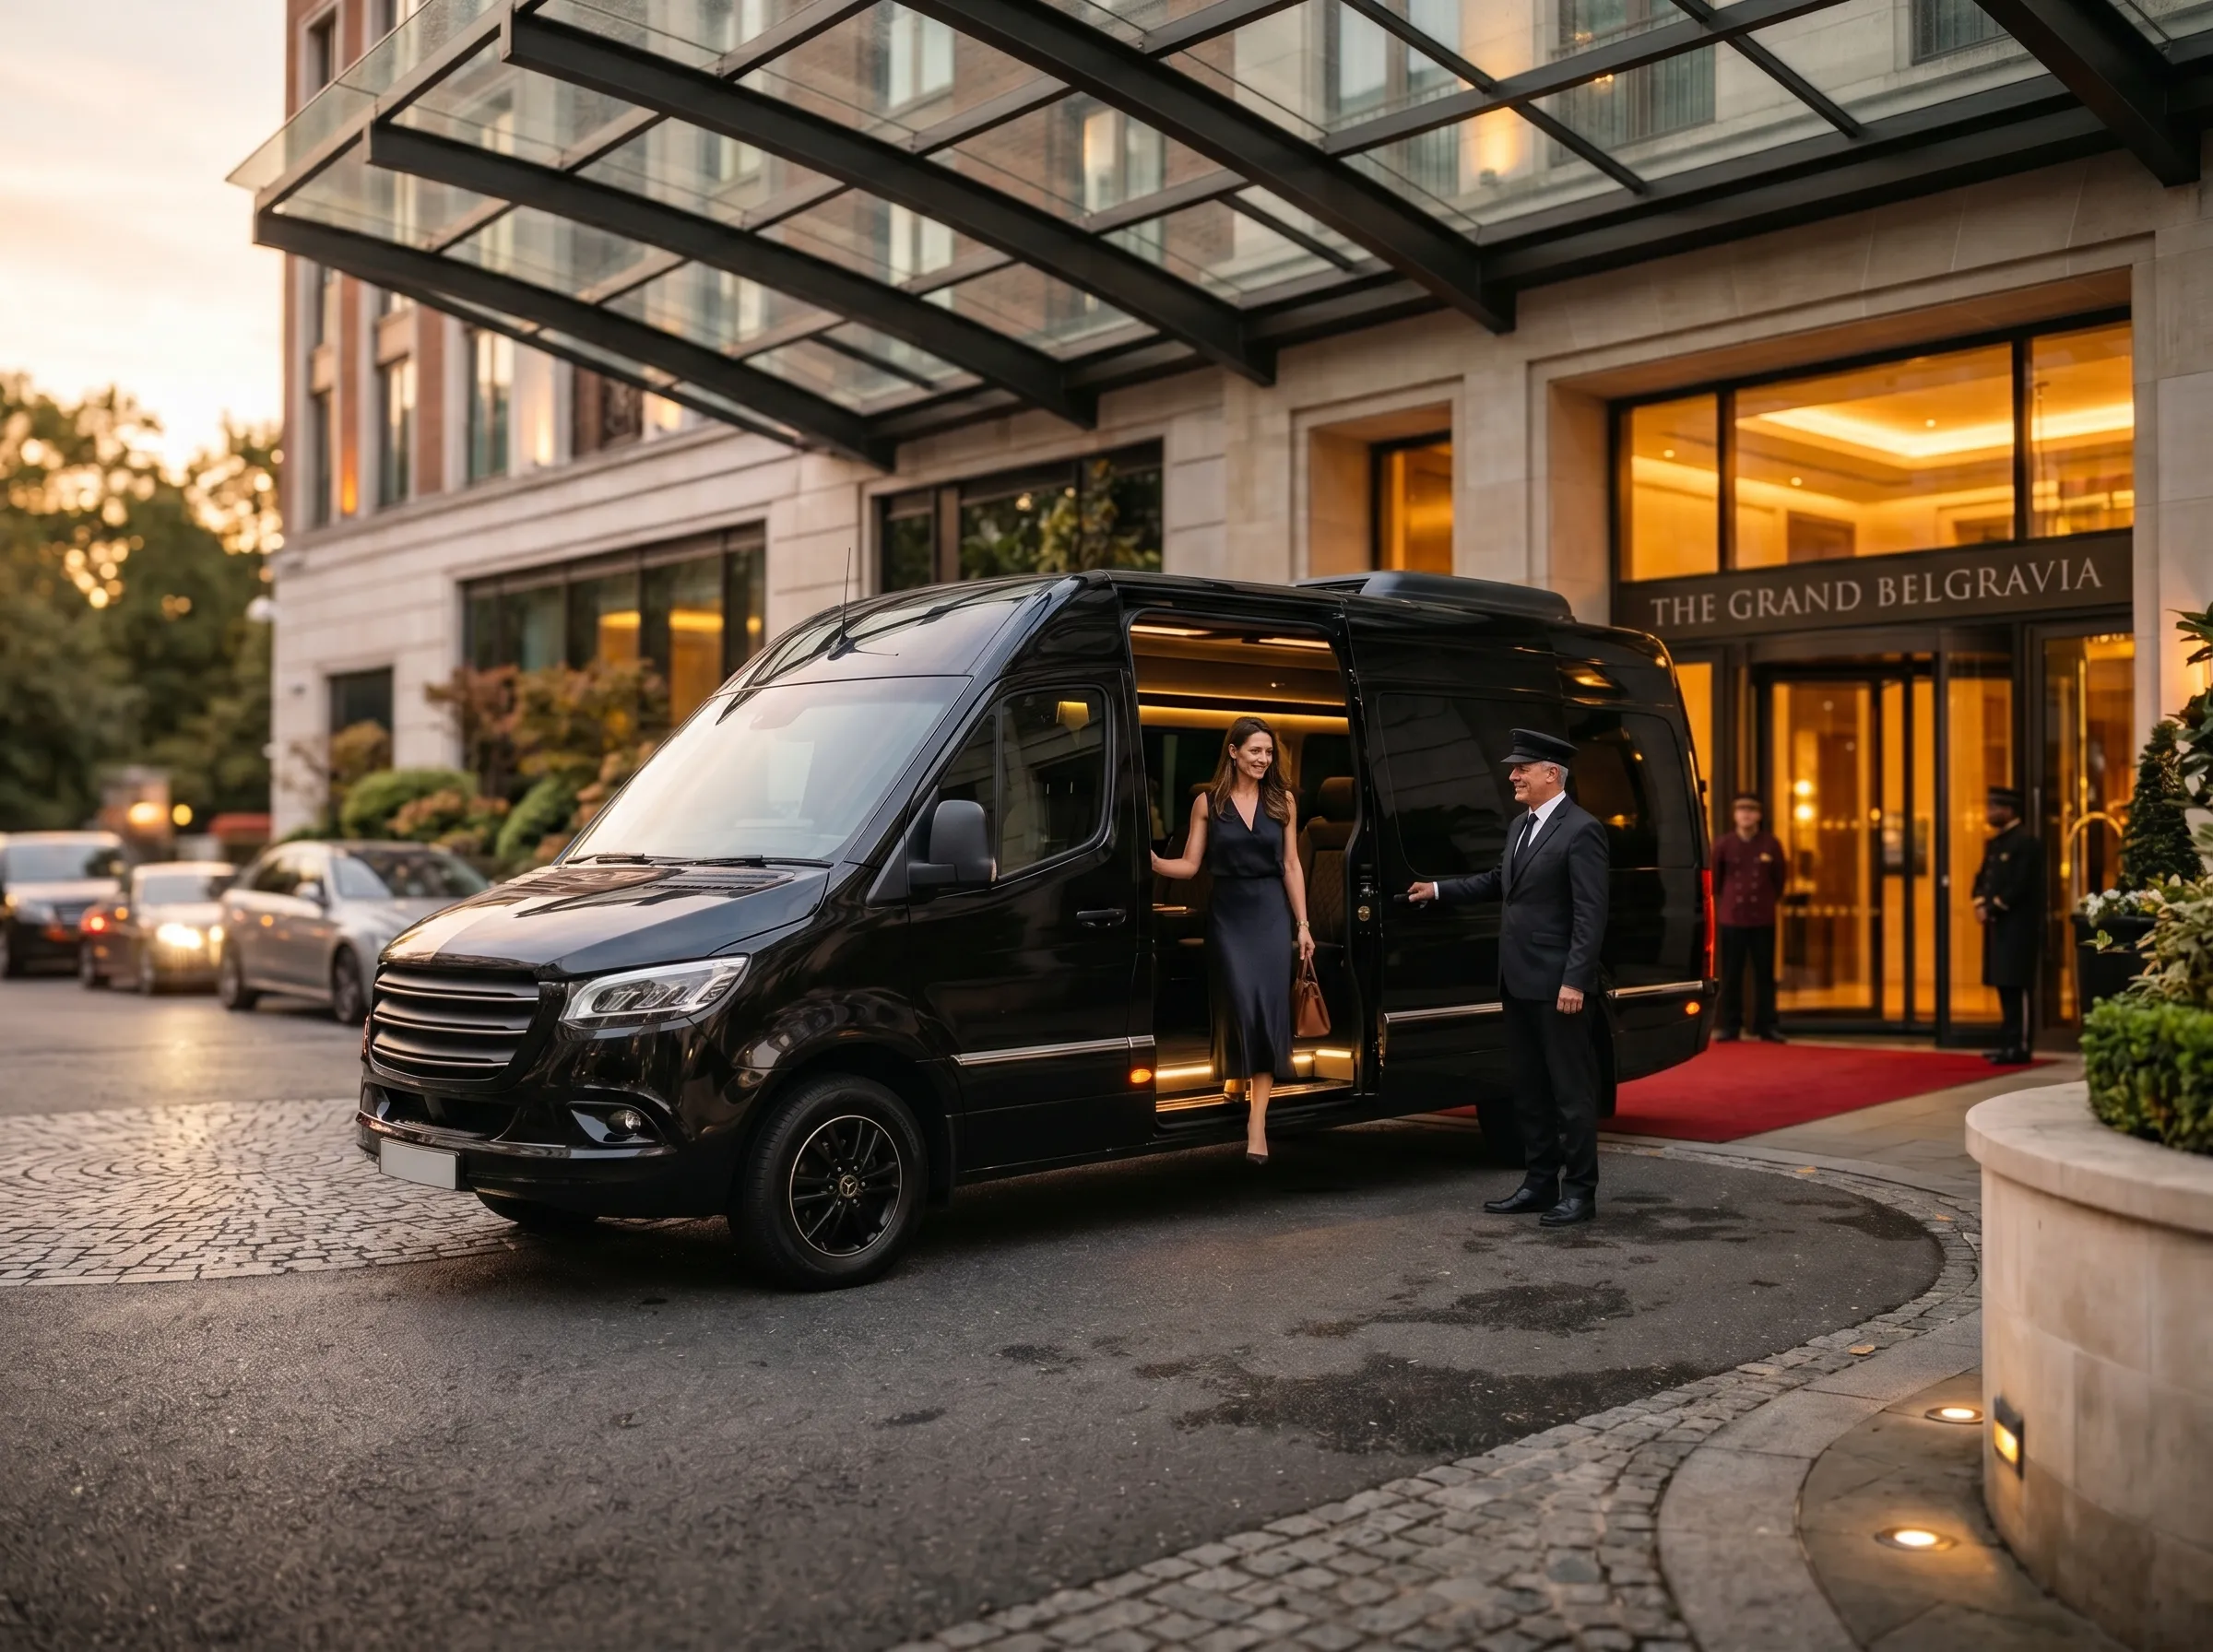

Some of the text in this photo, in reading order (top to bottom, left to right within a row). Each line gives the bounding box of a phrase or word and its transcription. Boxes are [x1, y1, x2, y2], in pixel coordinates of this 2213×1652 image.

[1651, 557, 2103, 626] THE GRAND BELGRAVIA
